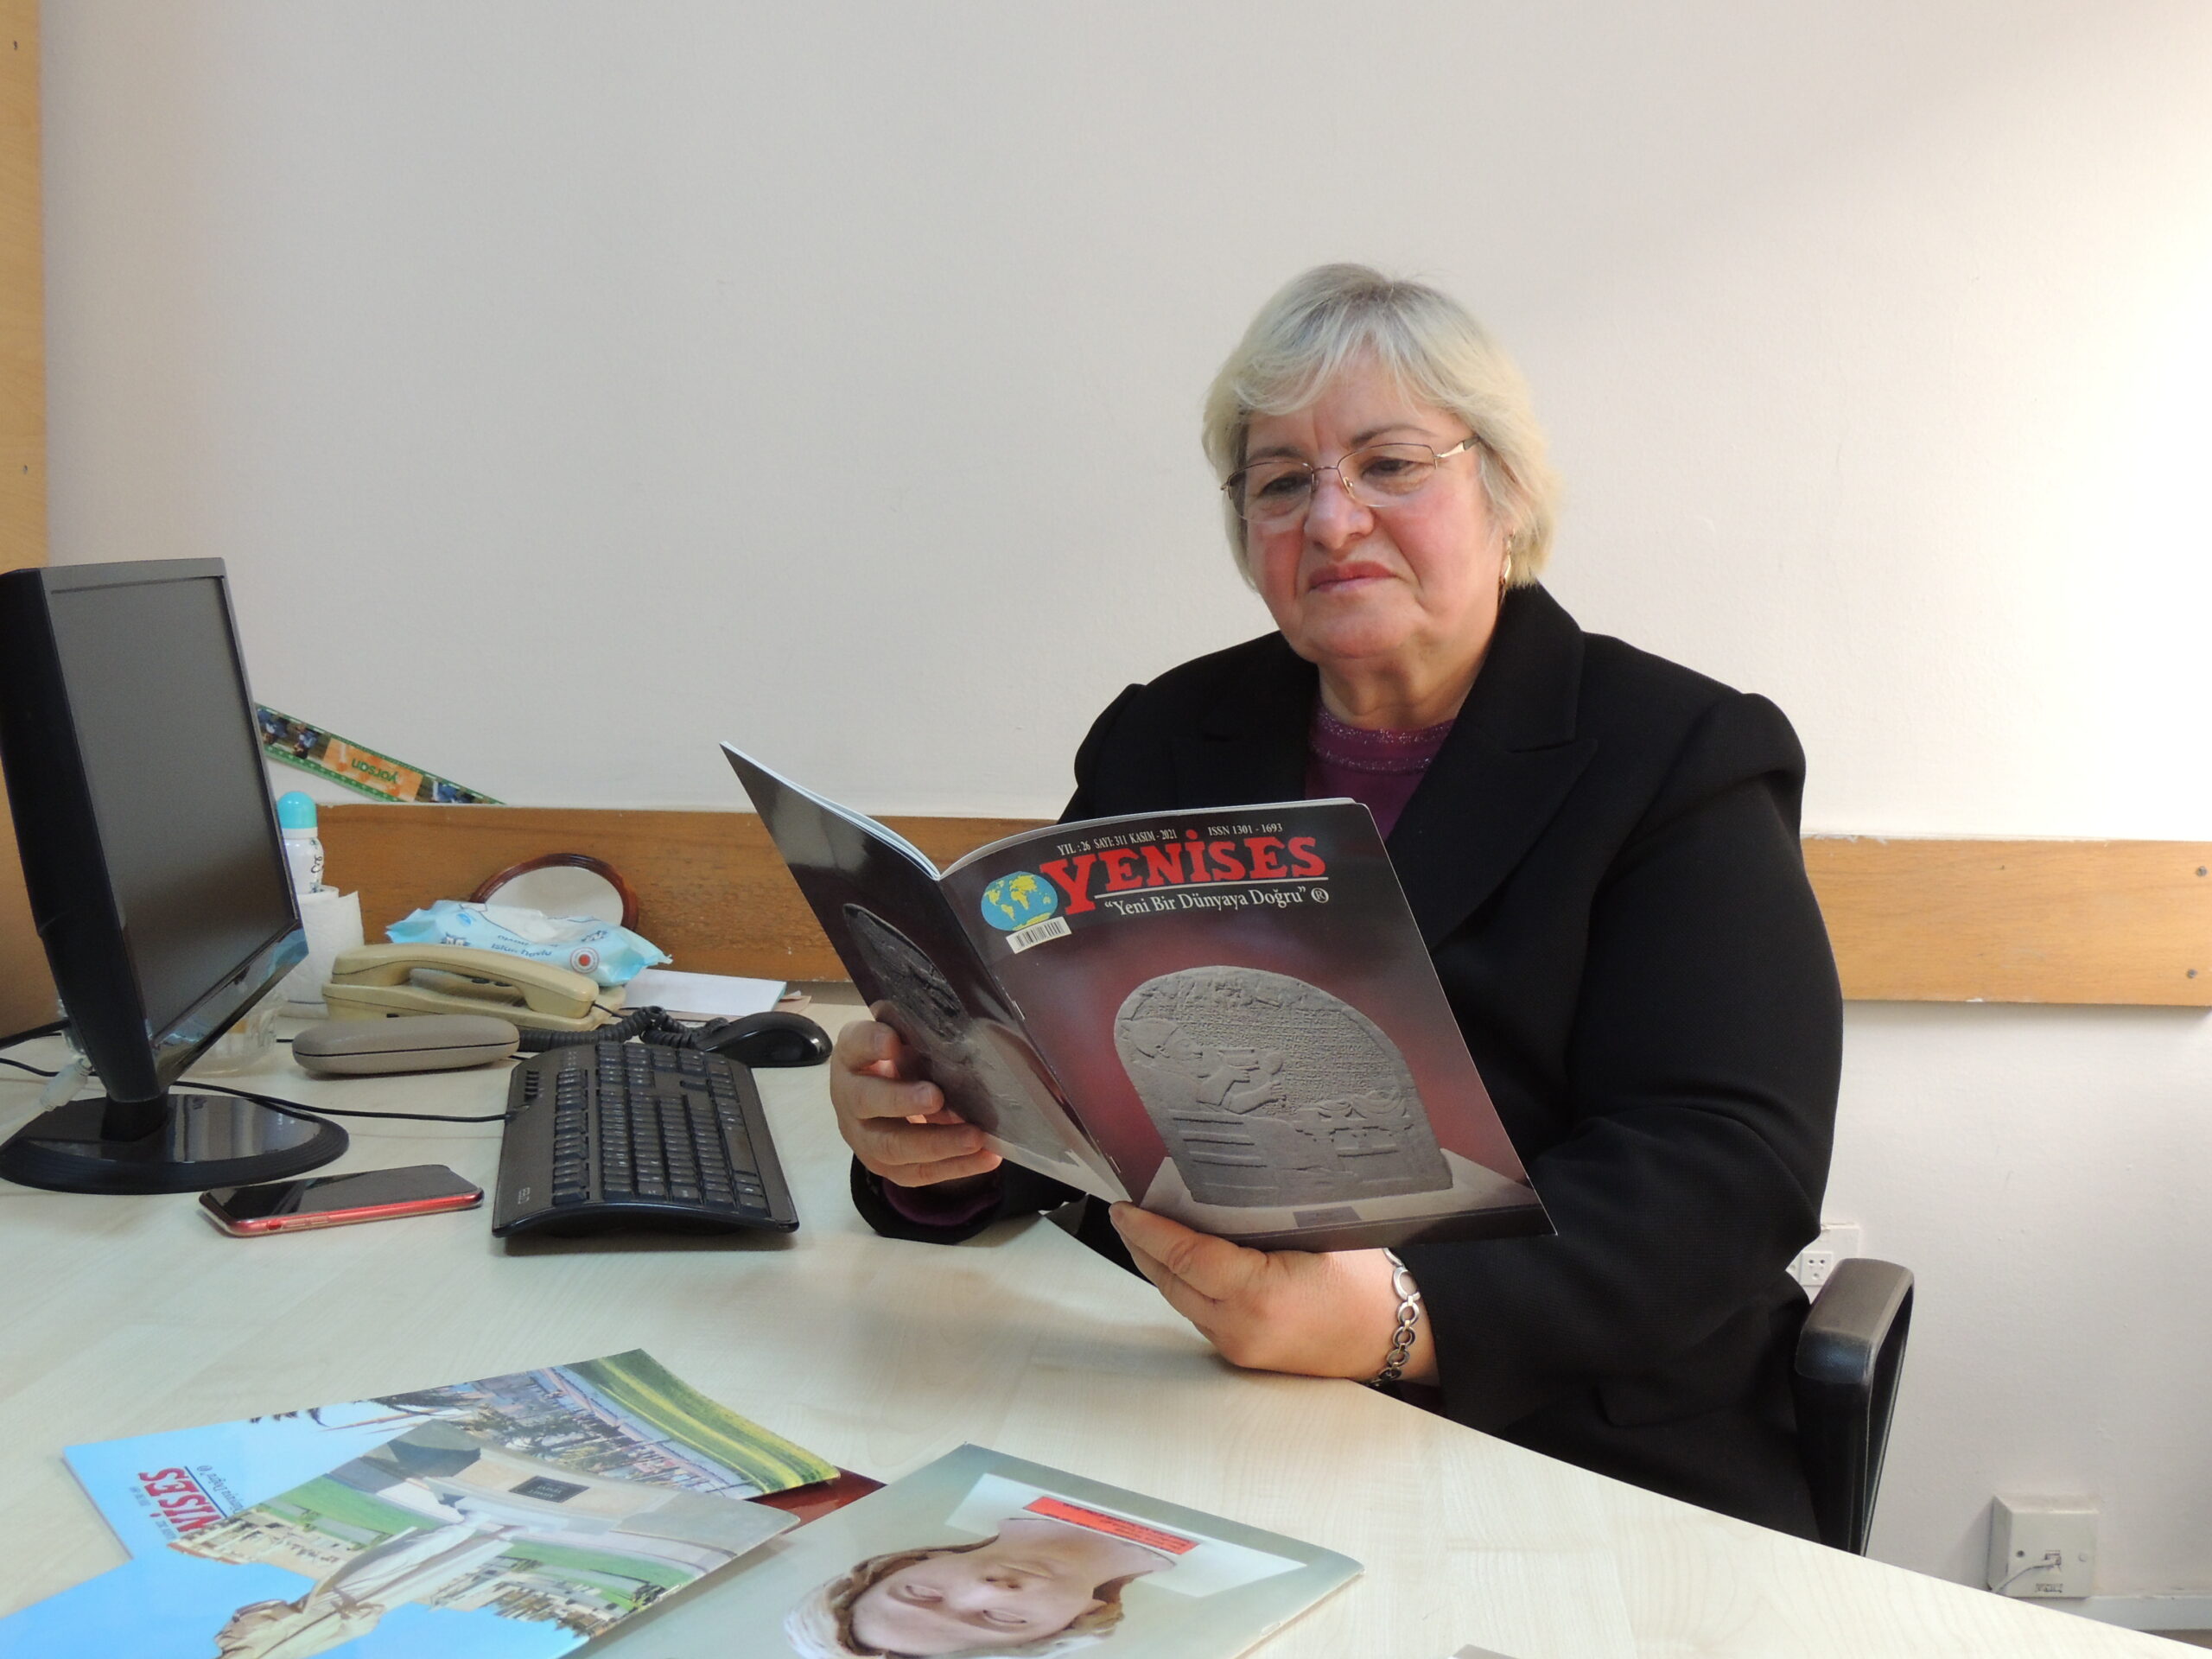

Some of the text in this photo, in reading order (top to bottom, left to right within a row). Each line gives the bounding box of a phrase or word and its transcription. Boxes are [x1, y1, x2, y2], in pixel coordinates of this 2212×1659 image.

[1208, 825, 1230, 836] ISSN
[1232, 824, 1253, 835] 1301
[1262, 823, 1283, 833] 1693
[1058, 844, 1076, 855] YIL
[1129, 830, 1155, 843] KASIM
[1160, 830, 1177, 840] 2021
[1039, 830, 1326, 915] YENİSES
[1150, 895, 1176, 912] Bir
[1177, 893, 1249, 911] Dünyaya
[138, 1467, 221, 1533] NİSES
